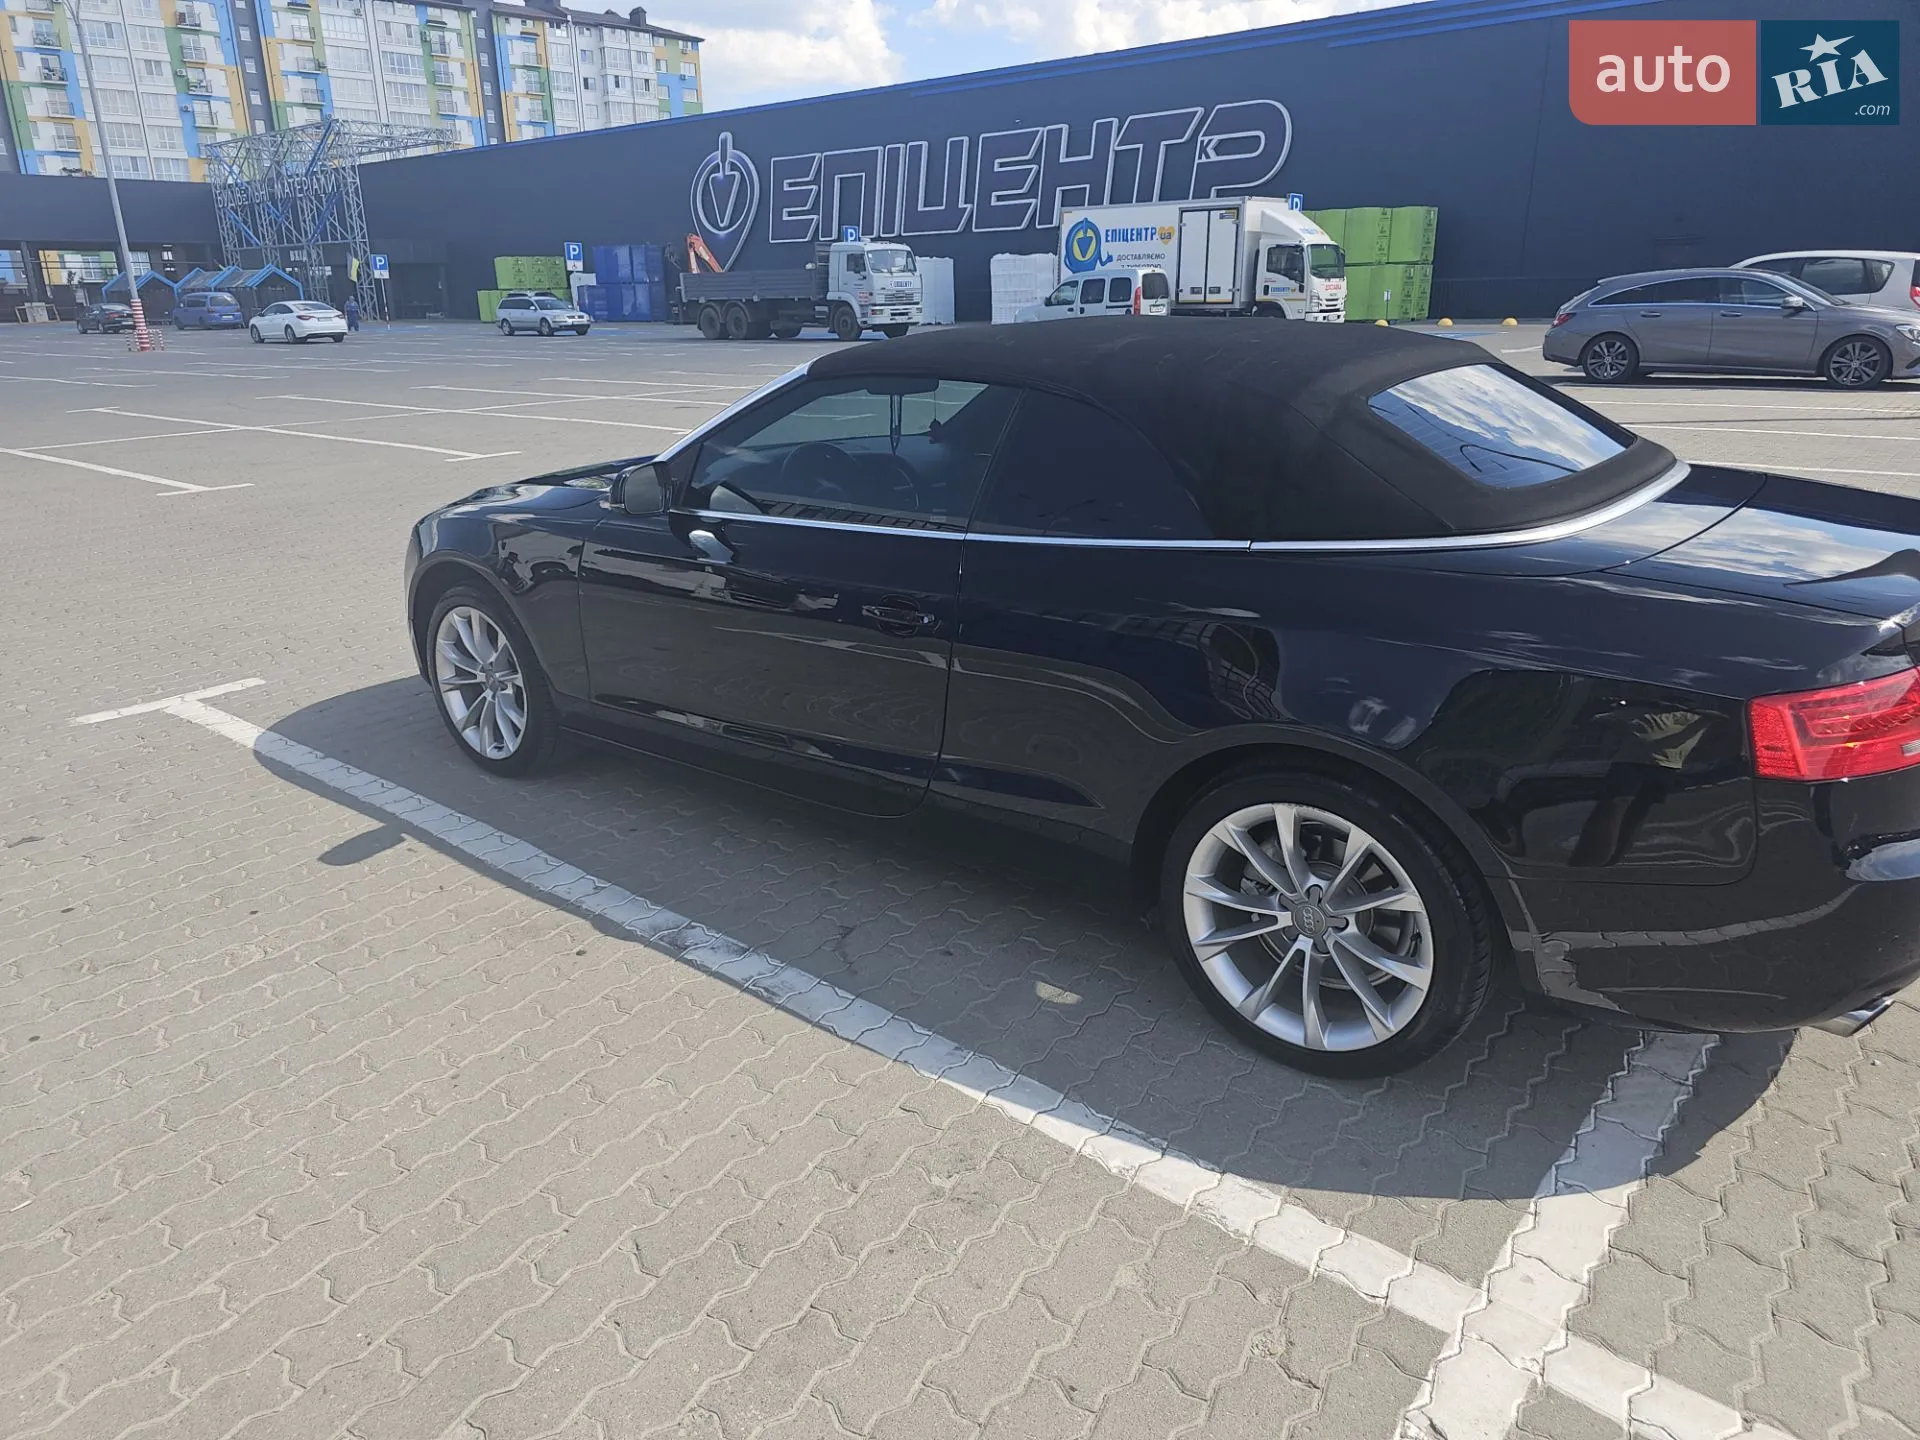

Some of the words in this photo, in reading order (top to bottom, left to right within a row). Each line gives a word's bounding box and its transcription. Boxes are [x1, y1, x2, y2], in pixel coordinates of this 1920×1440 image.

[569, 245, 579, 259] P
[1116, 253, 1166, 261] ДОСТАВЛЯЄМО
[376, 257, 385, 269] P
